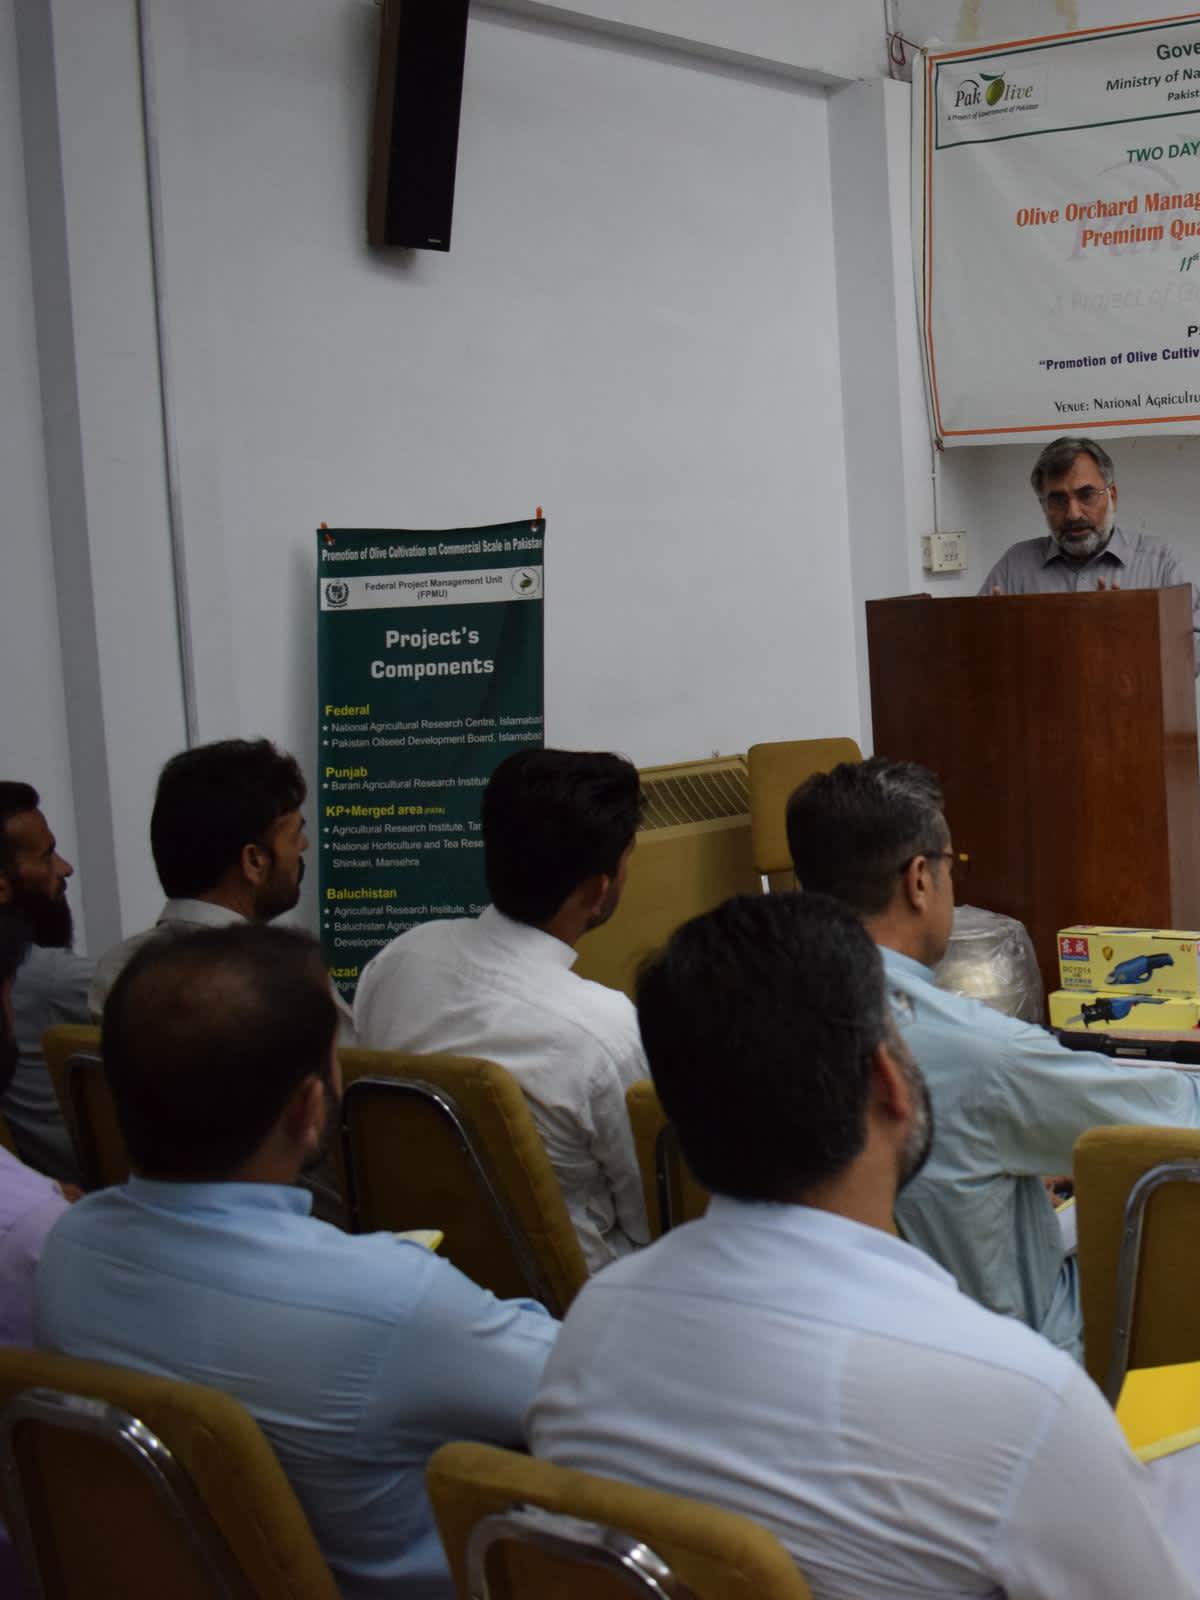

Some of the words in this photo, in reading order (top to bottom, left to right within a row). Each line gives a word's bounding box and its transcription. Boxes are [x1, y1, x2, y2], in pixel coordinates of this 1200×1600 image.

[1105, 72, 1161, 91] Ministry
[1165, 69, 1179, 82] of
[954, 88, 981, 107] Pak
[1127, 146, 1163, 163] TWO
[1016, 205, 1058, 228] Olive
[1065, 195, 1137, 221] Orchard
[1081, 224, 1164, 248] Premium
[1110, 351, 1123, 365] of
[1127, 348, 1158, 364] Olive
[321, 548, 358, 561] Promotion
[369, 546, 387, 559] Olive
[388, 544, 427, 558] Cultivation
[438, 541, 481, 554] Commercial
[482, 539, 503, 552] Scale
[365, 581, 396, 591] Federal
[398, 579, 428, 591] Project
[430, 577, 483, 589] Management
[485, 575, 503, 586] Unit
[417, 589, 448, 600] (FPMU)
[385, 627, 480, 649] Project's
[370, 658, 494, 680] Components
[325, 704, 370, 717] Federal
[369, 721, 419, 732] Agricultural
[421, 718, 463, 729] Research
[407, 734, 465, 746] Development
[325, 766, 368, 780] Punjab
[363, 779, 412, 791] Agricultural
[414, 777, 455, 788] Research
[325, 805, 395, 819] KP+Merged
[332, 824, 382, 836] Agricultural
[384, 823, 427, 833] Research
[372, 839, 422, 850] Horticulture
[424, 839, 441, 849] and
[443, 839, 459, 849] Tea
[327, 887, 397, 900] Baluchistan
[334, 904, 384, 916] Agricultural
[386, 904, 428, 915] Research
